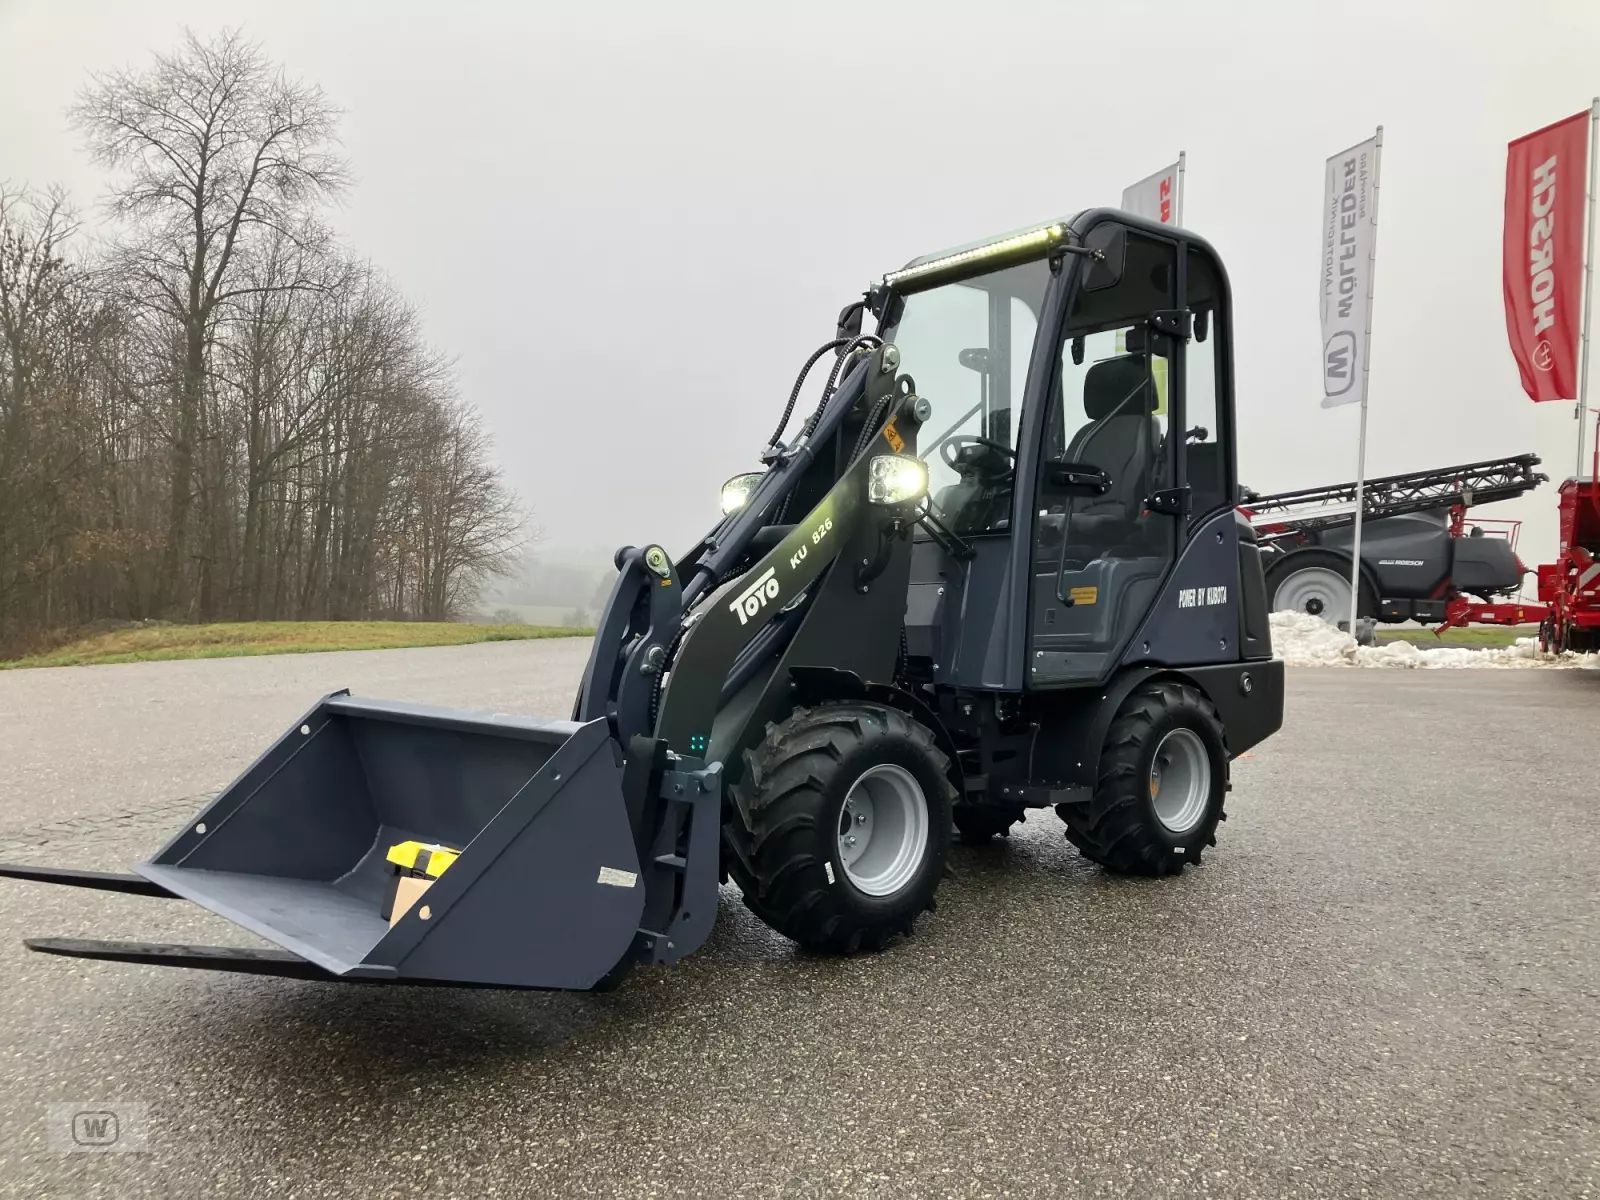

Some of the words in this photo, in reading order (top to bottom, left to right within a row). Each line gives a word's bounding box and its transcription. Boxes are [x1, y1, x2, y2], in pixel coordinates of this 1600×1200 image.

[729, 566, 779, 625] TOYO
[790, 544, 808, 570] KU
[812, 517, 833, 544] 826
[1179, 588, 1196, 608] POWER
[1198, 587, 1206, 606] BY
[1207, 585, 1227, 605] KUBOTA
